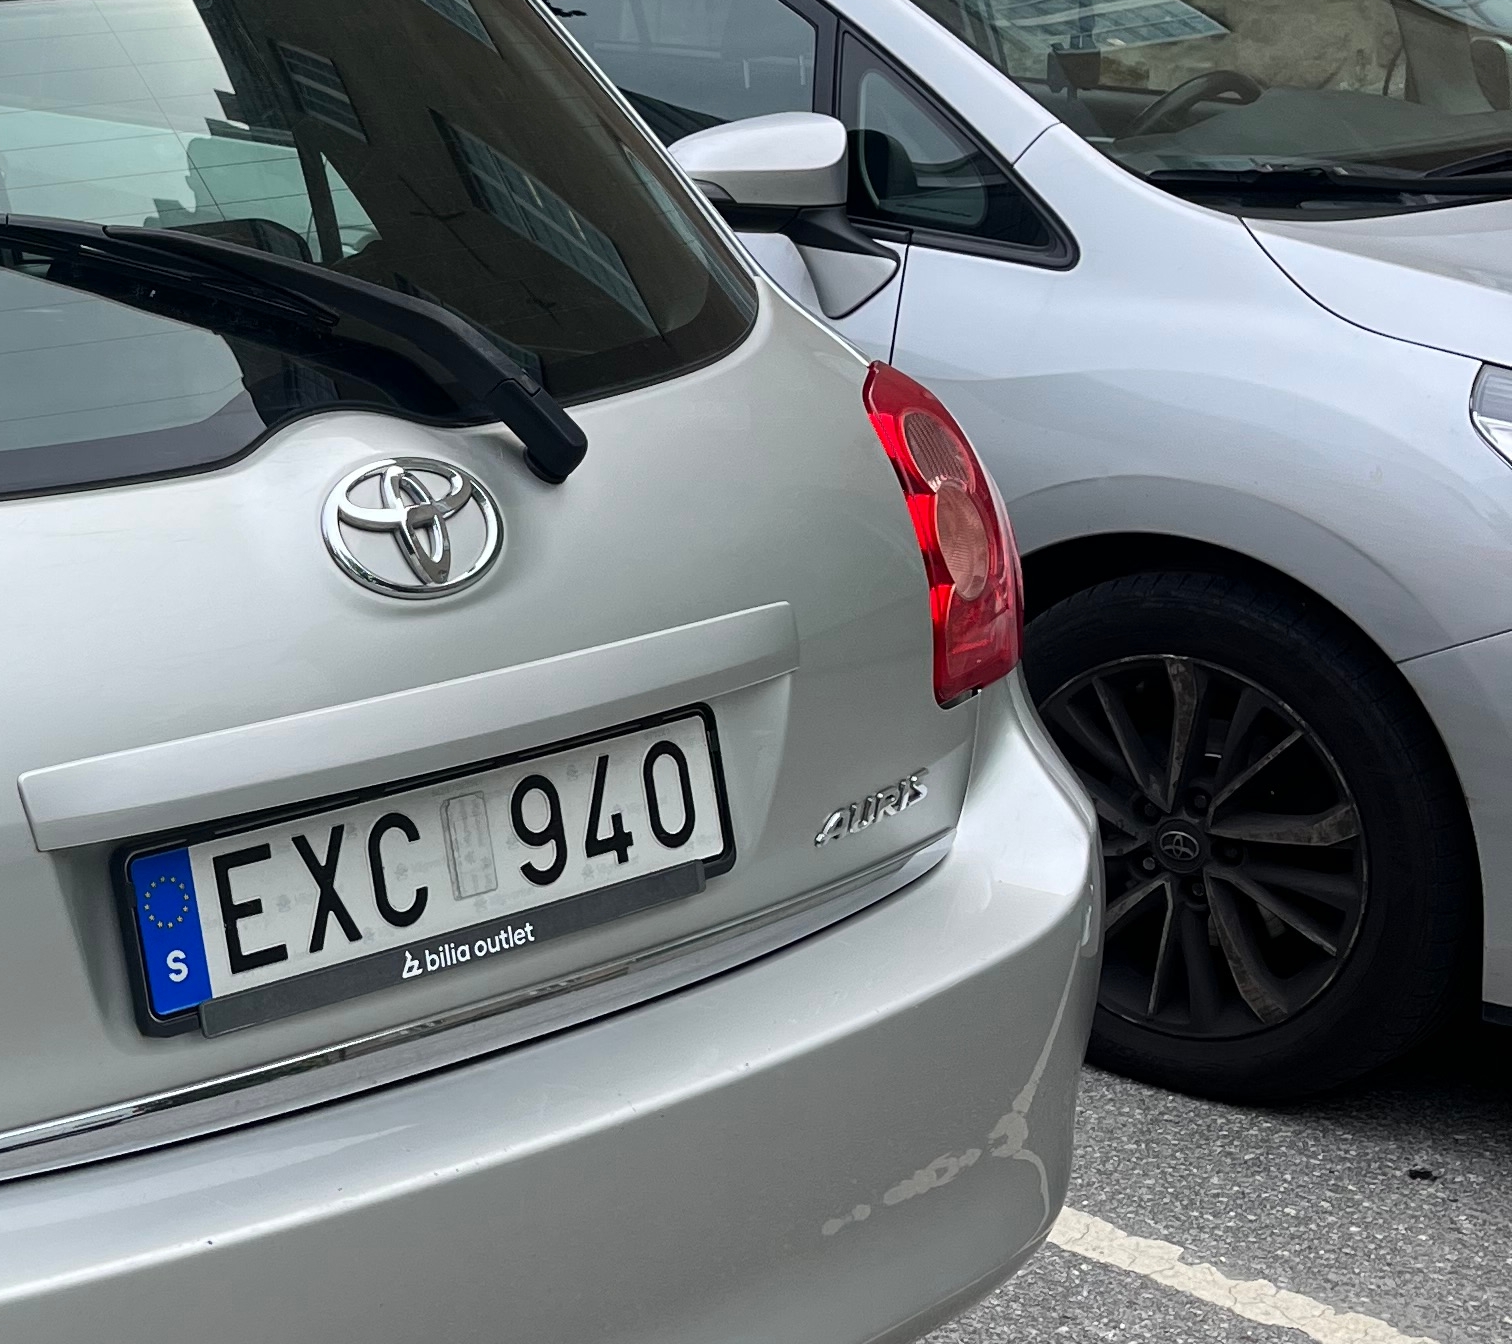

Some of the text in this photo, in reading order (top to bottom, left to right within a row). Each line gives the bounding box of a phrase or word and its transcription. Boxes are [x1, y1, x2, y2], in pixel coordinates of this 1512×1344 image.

[814, 767, 930, 849] AURIS
[212, 740, 696, 975] EXC 940
[167, 949, 189, 982] S
[424, 922, 535, 972] bilia outlet
